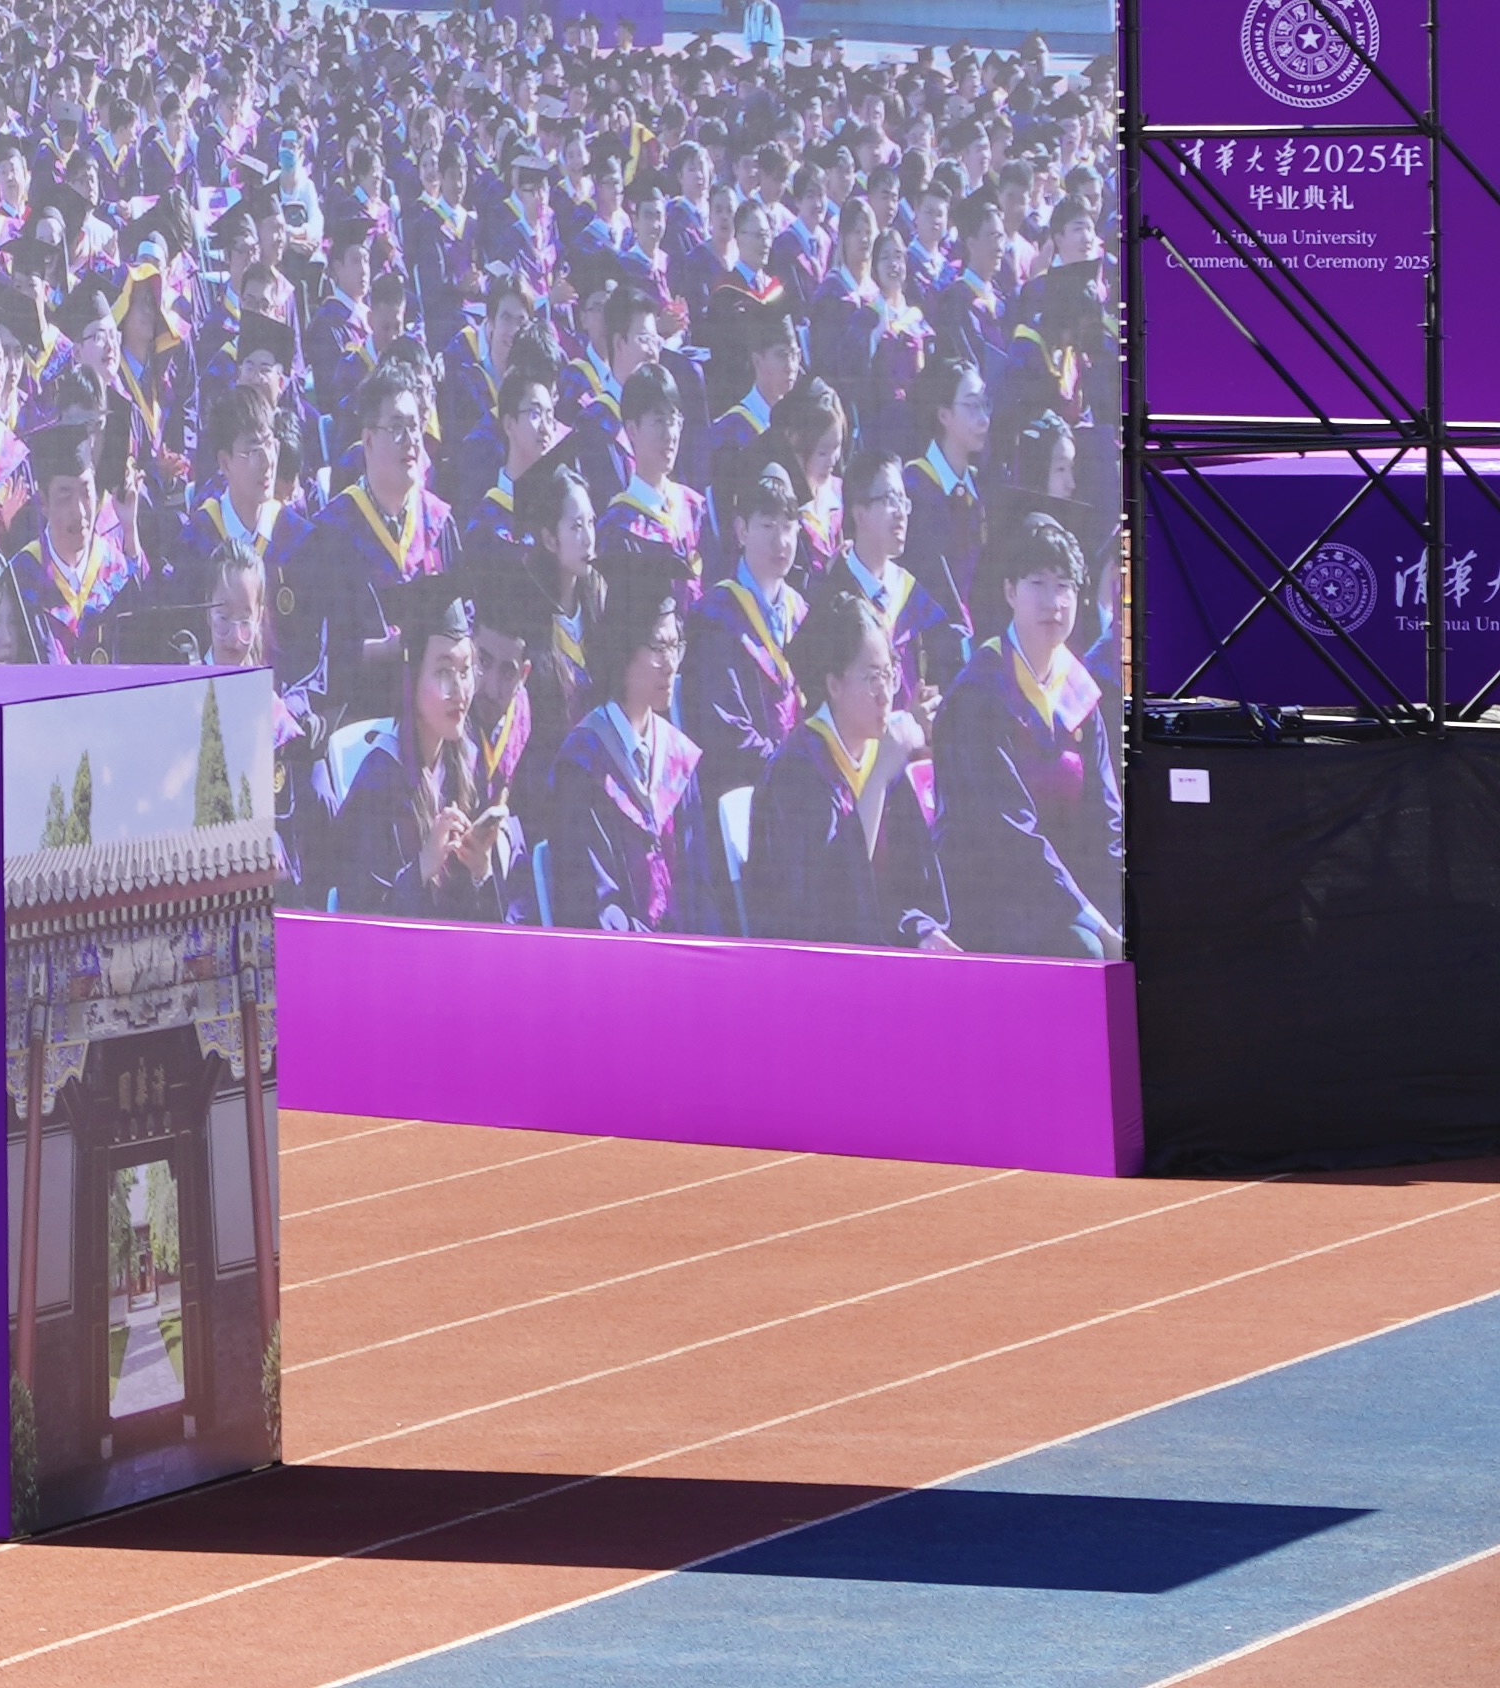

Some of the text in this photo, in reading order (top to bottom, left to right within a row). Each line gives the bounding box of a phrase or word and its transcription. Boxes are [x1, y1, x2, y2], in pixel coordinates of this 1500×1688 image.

[1254, 21, 1280, 83] TSINGHUA
[1248, 184, 1355, 211] 毕业典礼
[1211, 229, 1377, 248] Tinghua University
[1165, 253, 1430, 272] Cmmencmnt Ceremony 2025
[1395, 615, 1470, 632] Tsinhua
